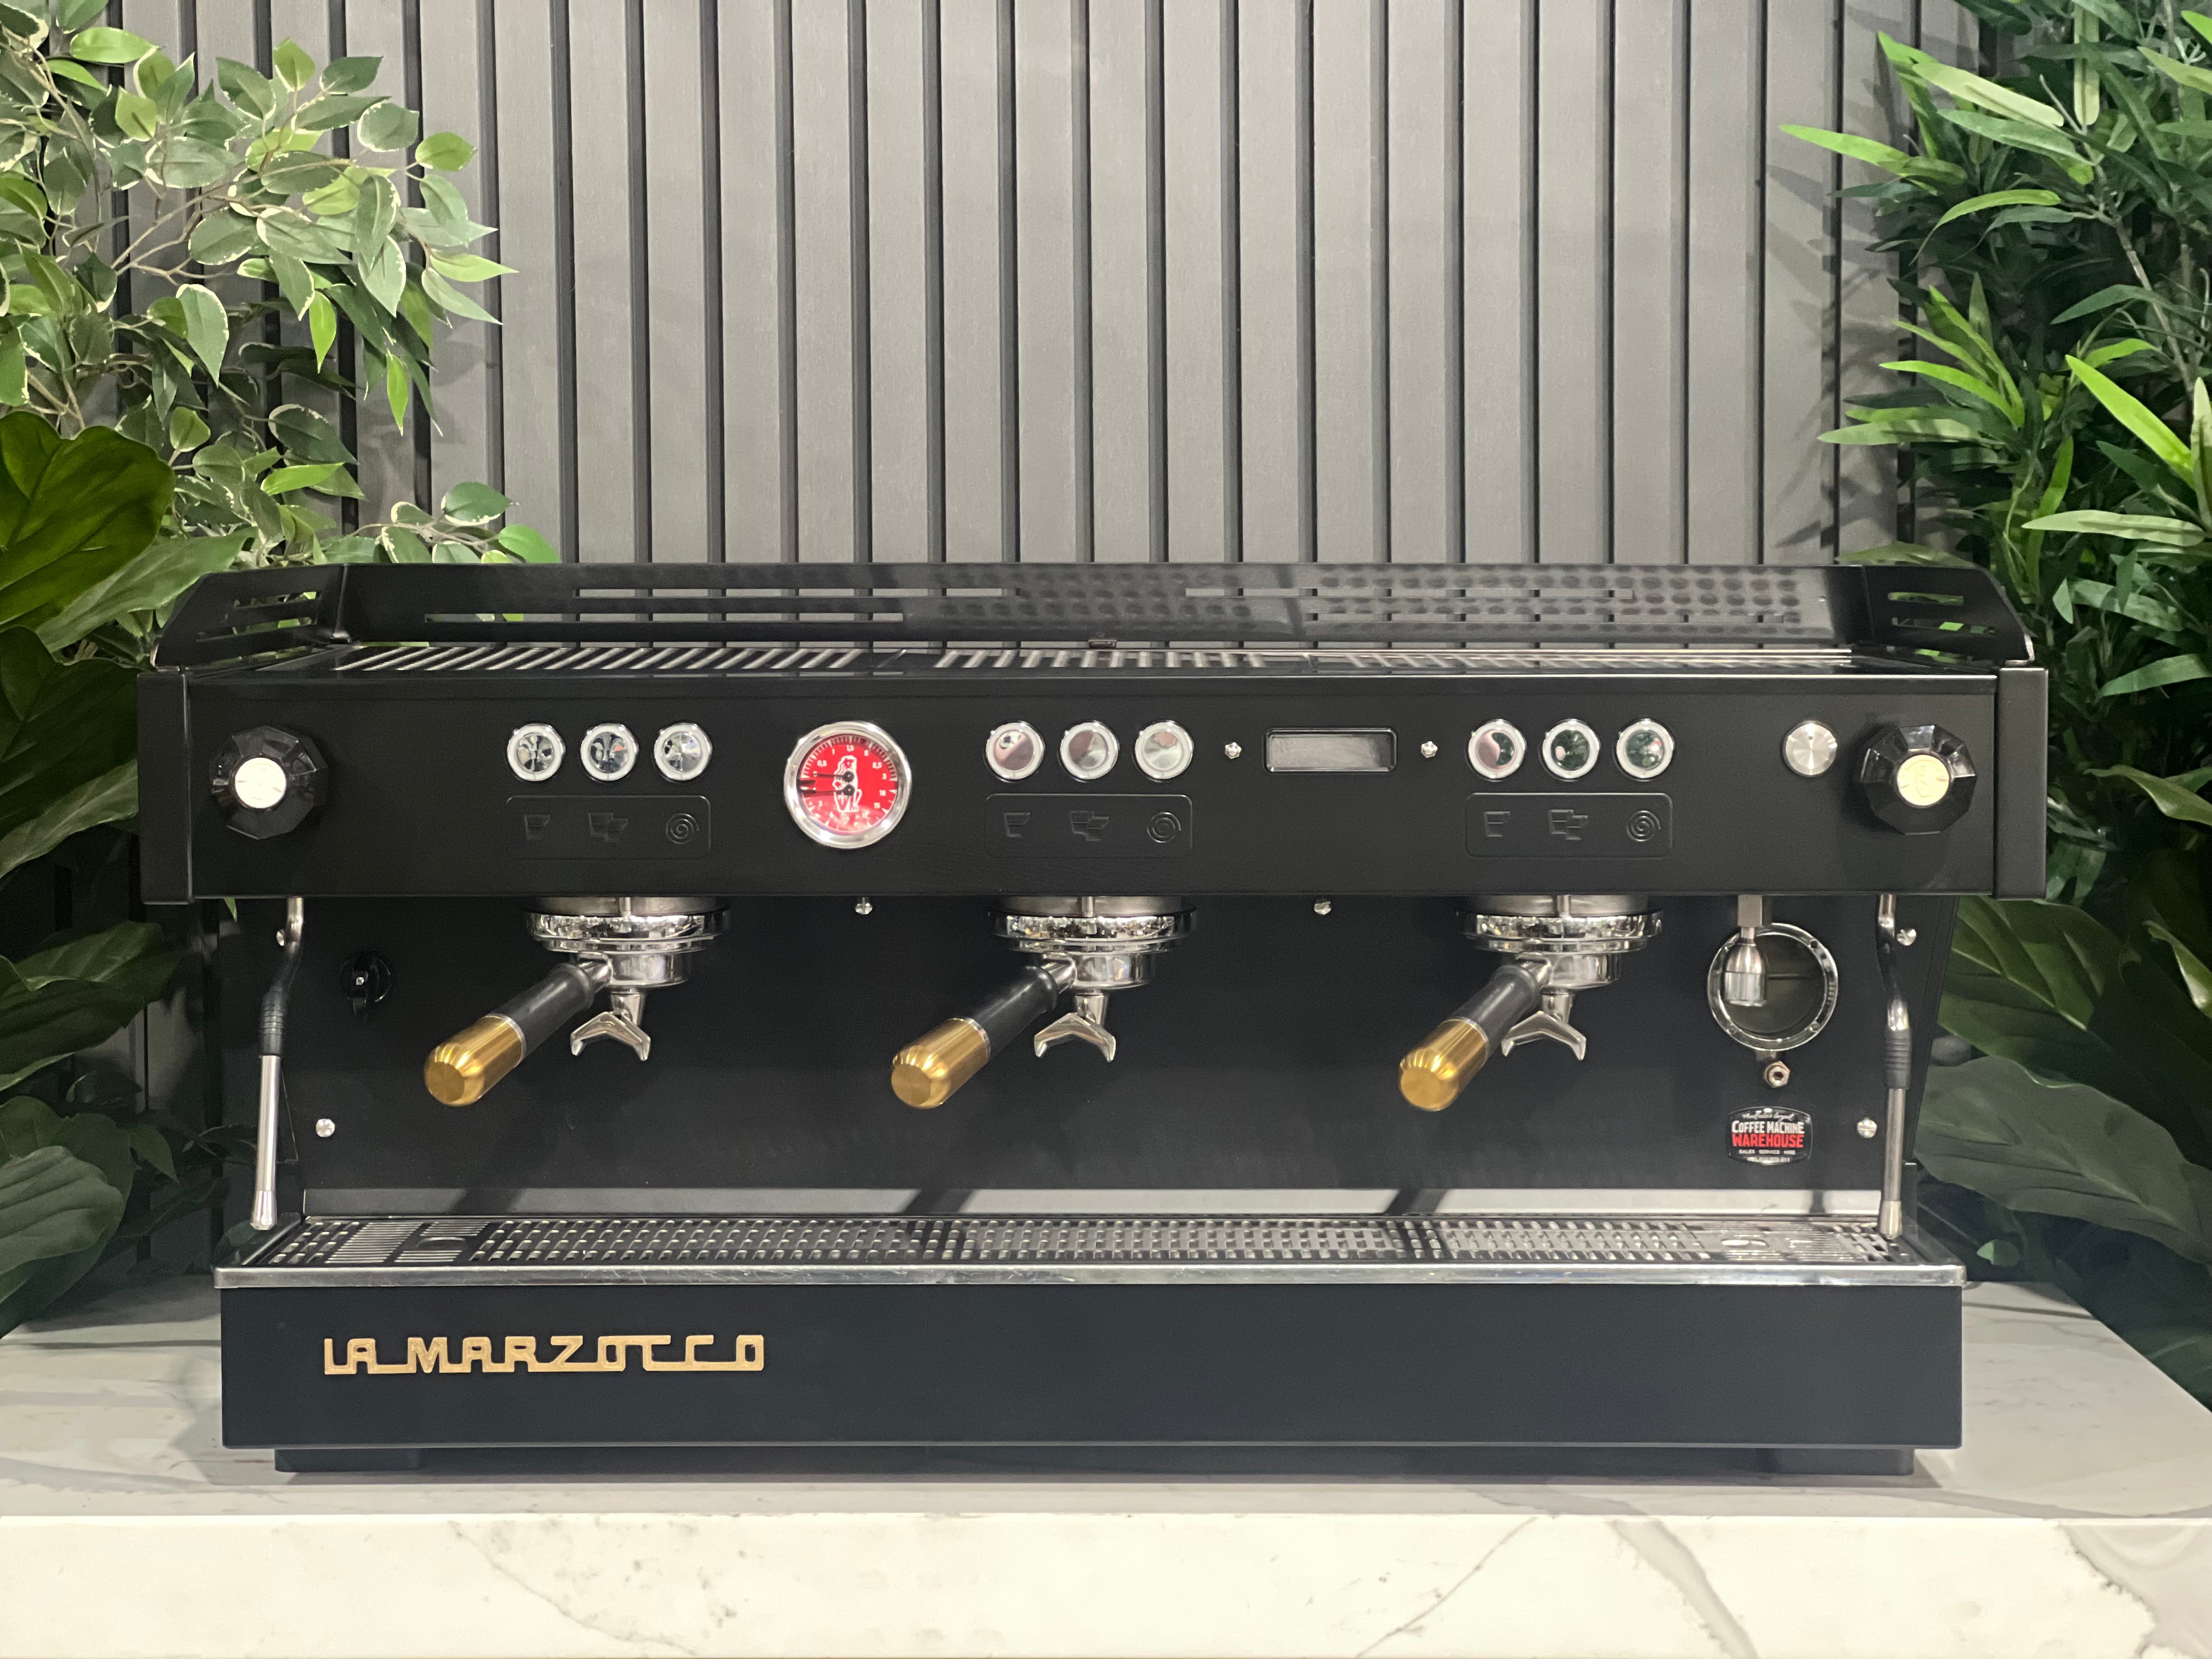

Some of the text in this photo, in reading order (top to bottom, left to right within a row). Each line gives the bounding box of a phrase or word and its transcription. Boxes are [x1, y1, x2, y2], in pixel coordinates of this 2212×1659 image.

[1732, 1120, 1805, 1134] COFFEE MACHINE
[1732, 1133, 1804, 1148] WAREHOUSE
[324, 1338, 376, 1375] LA
